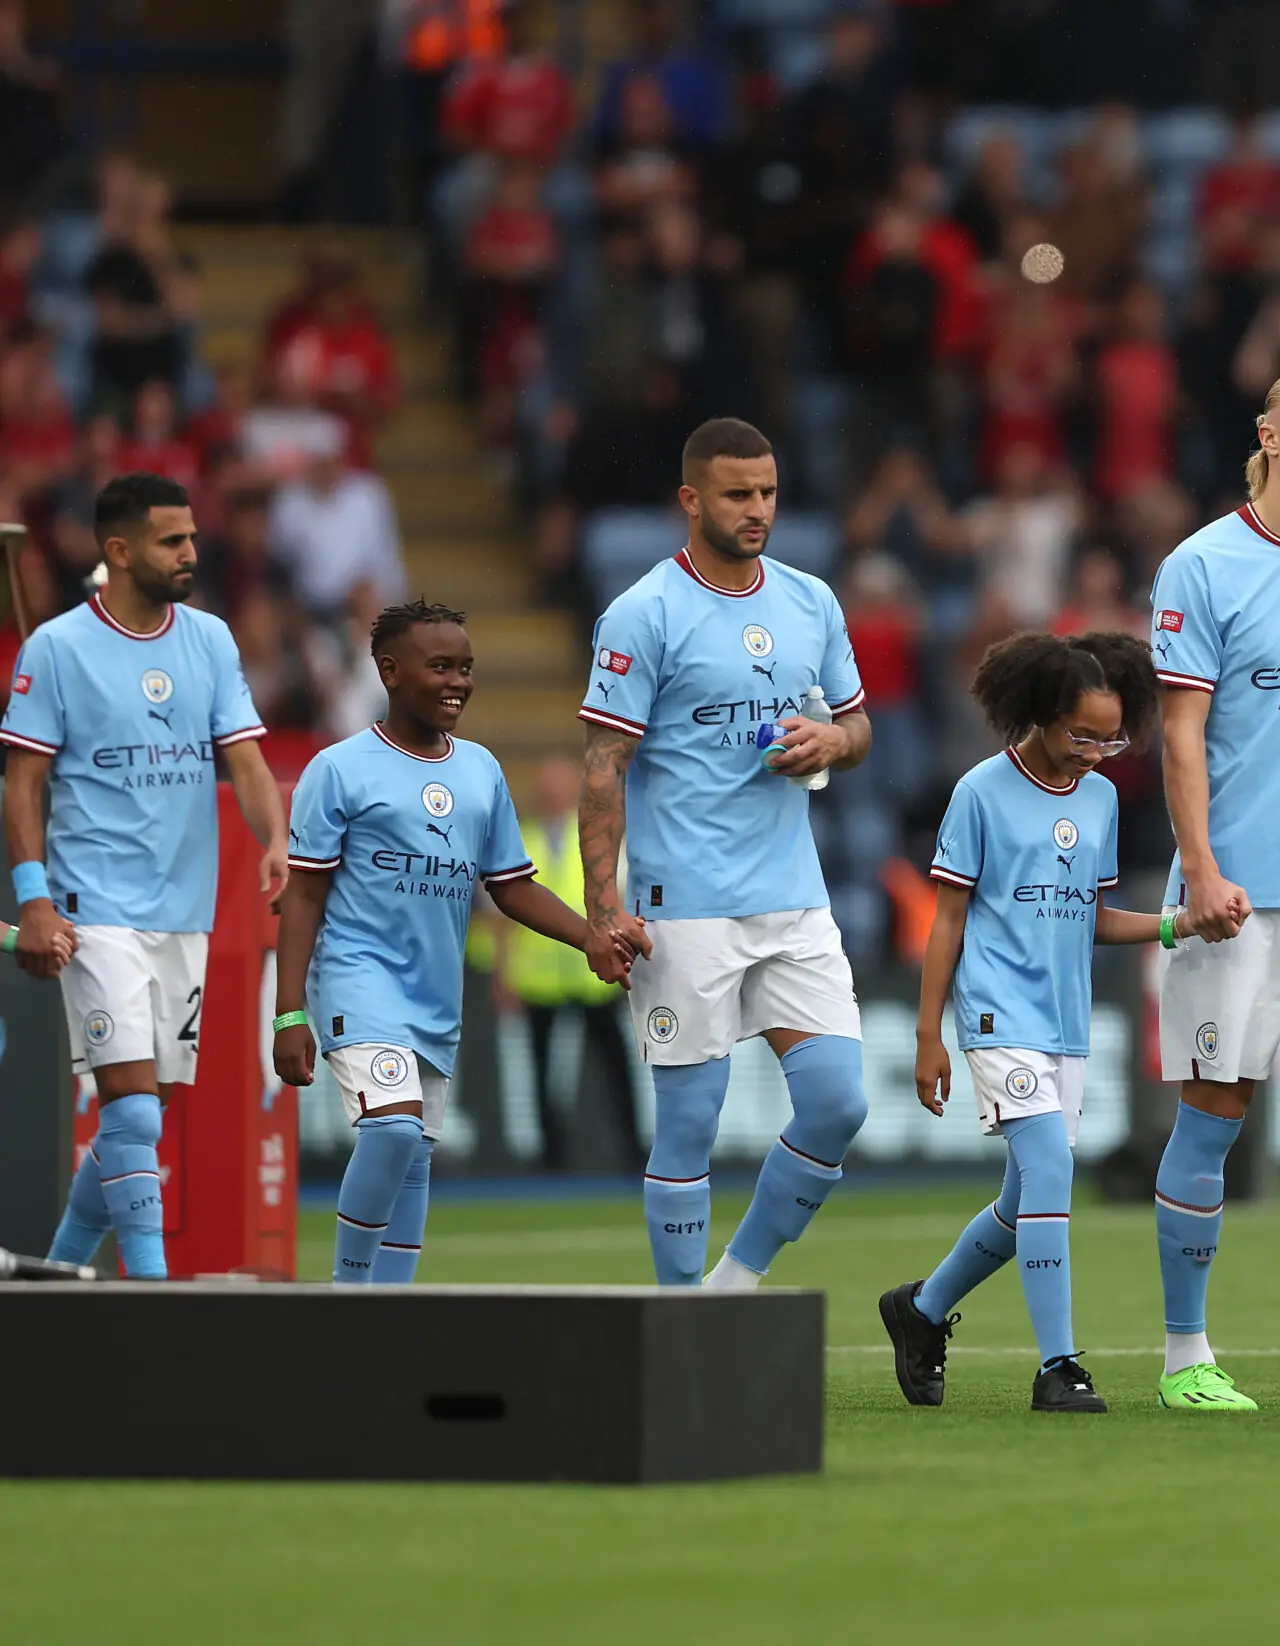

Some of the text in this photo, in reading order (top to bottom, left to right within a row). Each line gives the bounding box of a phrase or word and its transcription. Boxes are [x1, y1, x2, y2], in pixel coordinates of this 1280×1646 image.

[122, 770, 204, 789] AIRWAYS
[371, 849, 477, 882] ETIHAD
[394, 880, 468, 901] AIRWAYS
[177, 986, 202, 1041] 2
[664, 1219, 705, 1234] CITY
[1026, 1258, 1062, 1269] CITY
